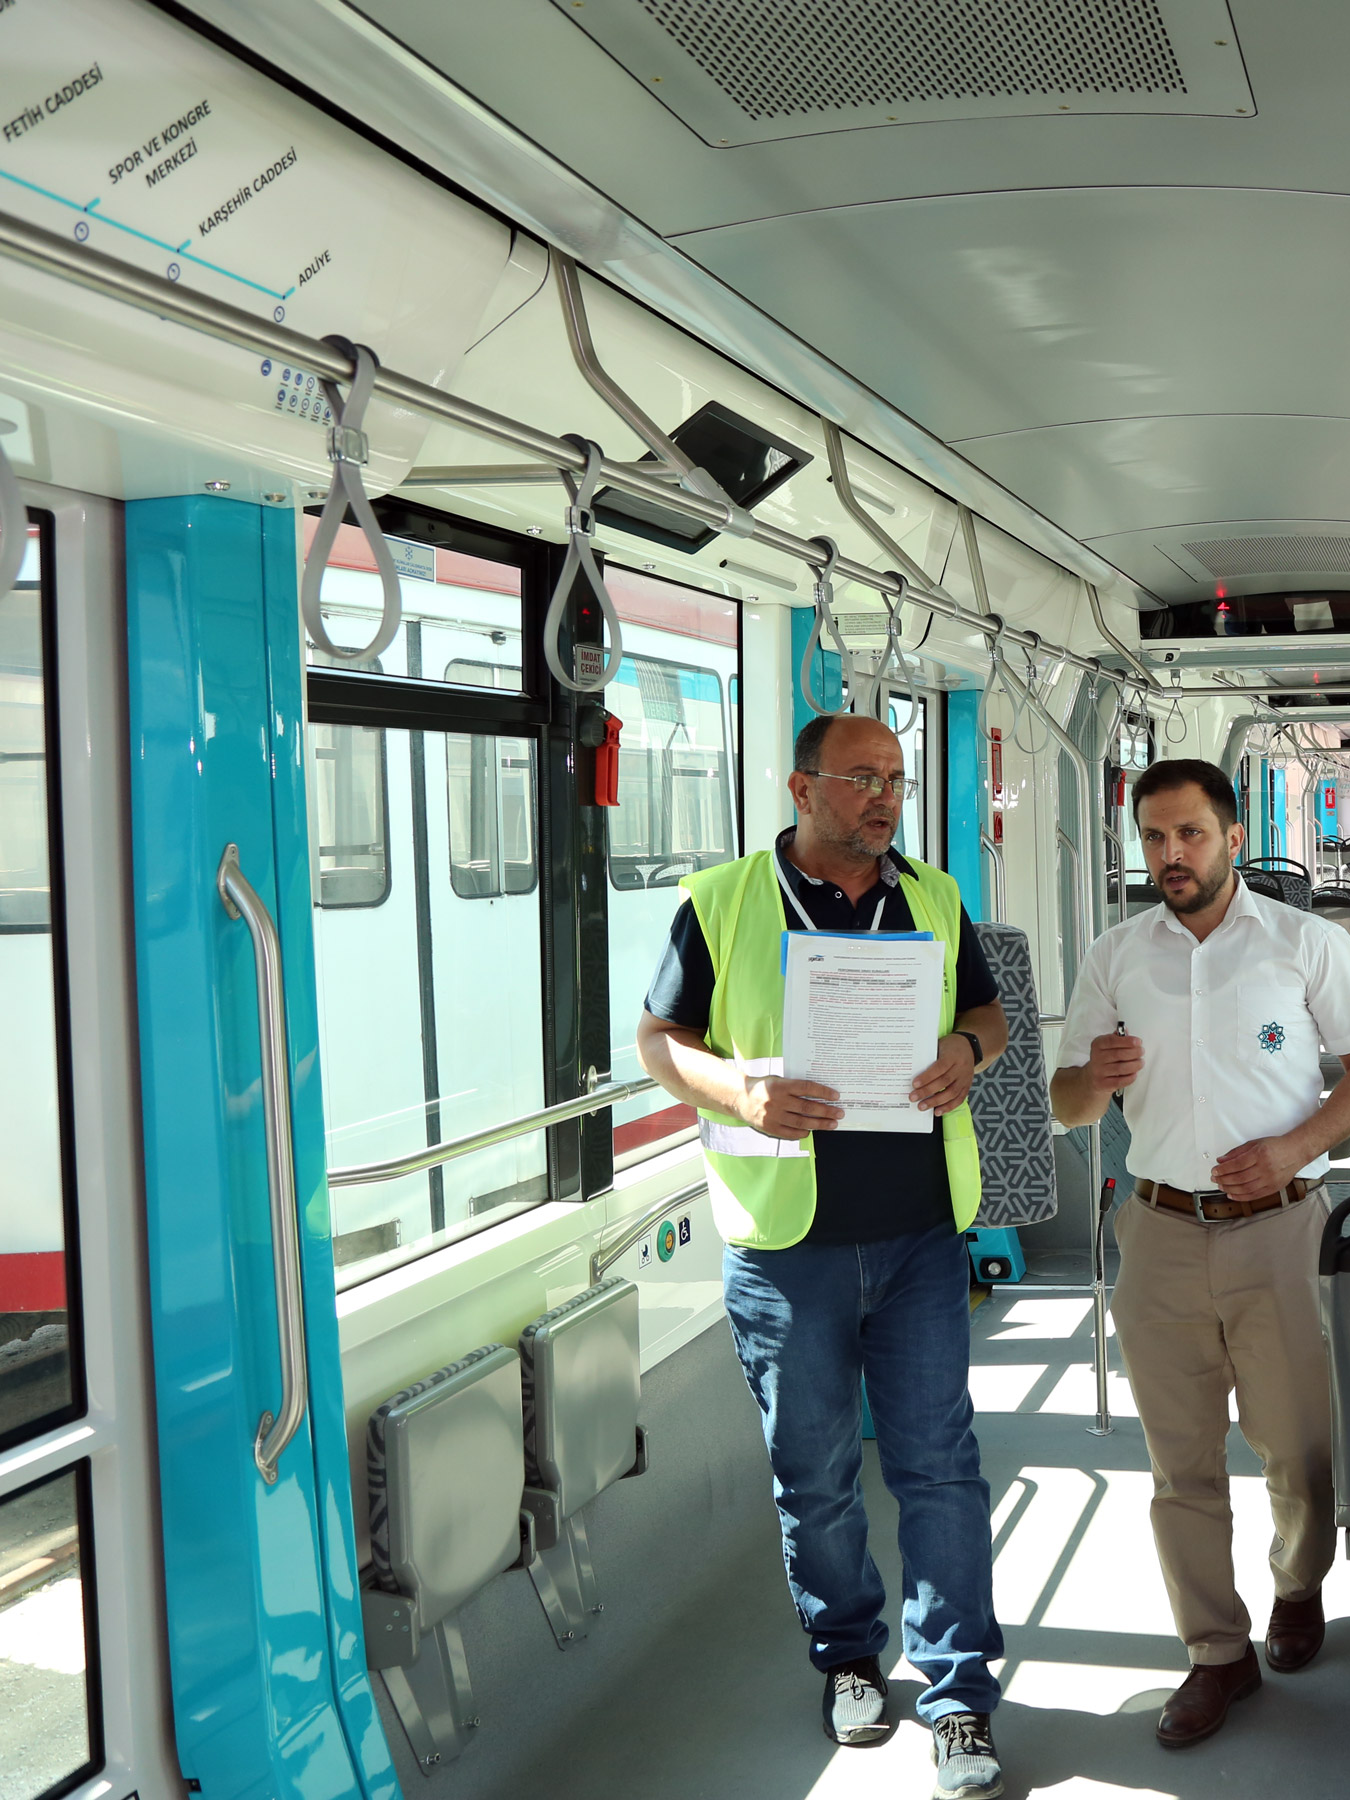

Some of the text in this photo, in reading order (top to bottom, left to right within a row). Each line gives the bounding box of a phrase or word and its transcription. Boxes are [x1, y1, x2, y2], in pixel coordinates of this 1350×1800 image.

[3, 61, 104, 142] FETİH CADDESİ
[108, 99, 212, 185] SPOR VE KONGRE
[145, 136, 199, 189] MERKEZİ
[198, 146, 298, 237] KARŞEHİR CADDESİ
[298, 249, 332, 287] ADLİYE
[580, 663, 602, 675] ÇEKİCİ
[581, 649, 601, 663] İMDAT
